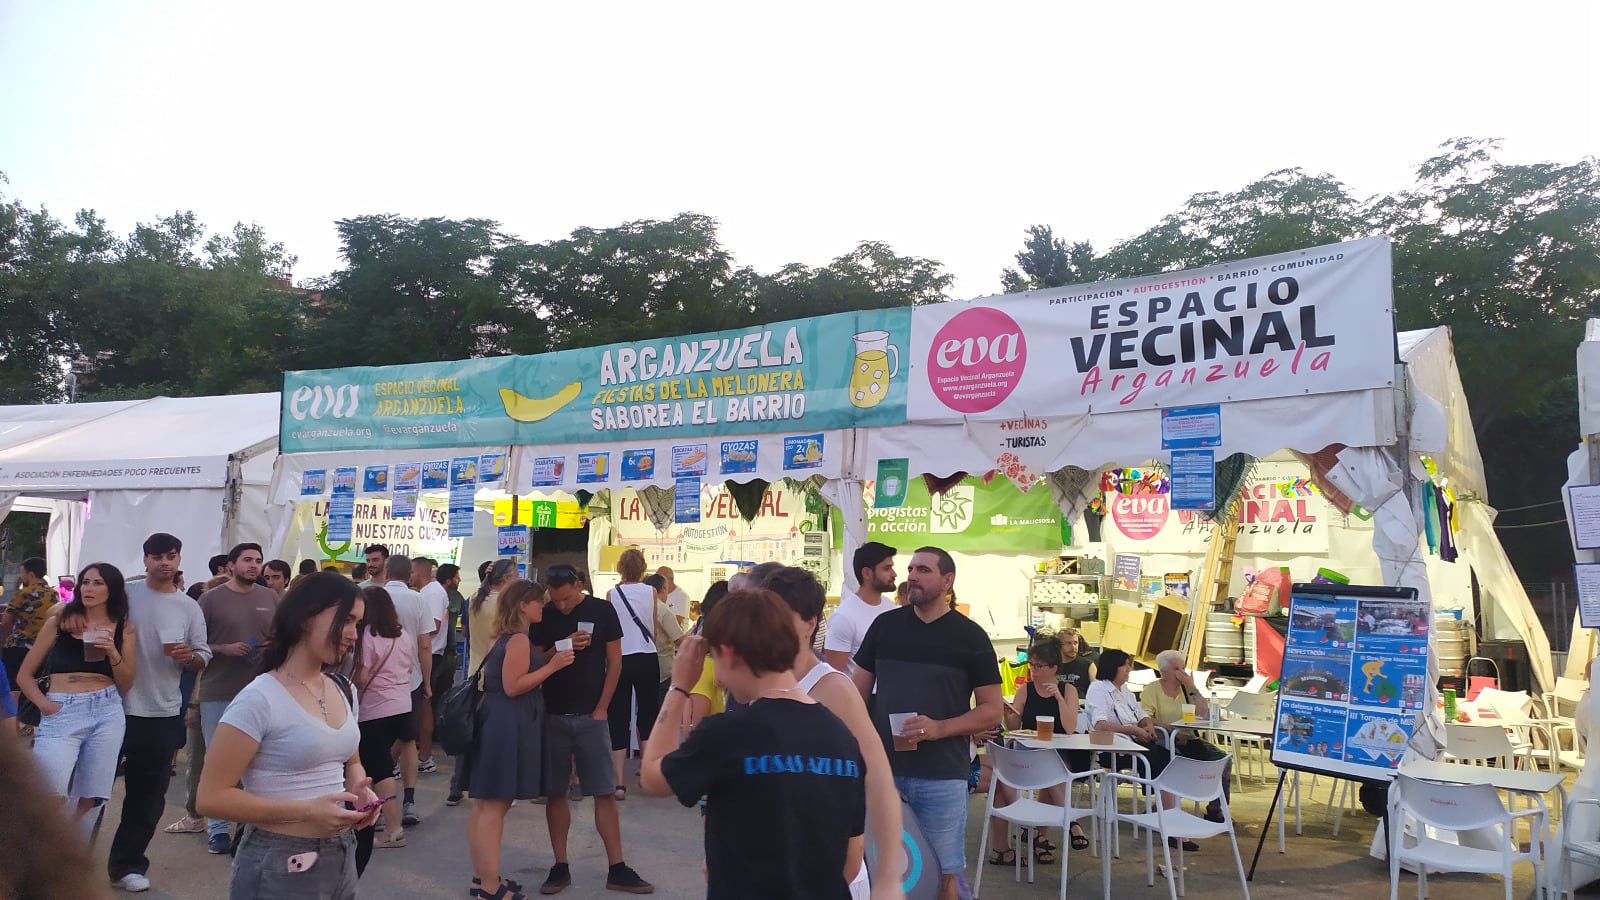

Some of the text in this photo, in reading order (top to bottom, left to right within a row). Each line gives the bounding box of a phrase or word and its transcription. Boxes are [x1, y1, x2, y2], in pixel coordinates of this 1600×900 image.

[1049, 253, 1344, 305] PARTICIPACIÓN AUTOGESTIÓN BARRIO COMUNIDAD
[1090, 276, 1299, 330] ESPACIO
[1070, 304, 1336, 374] VECINAL
[600, 326, 803, 386] ARGANZUELA
[937, 333, 1019, 368] eva
[937, 371, 1015, 385] Espacio Vecinal Arganzuela
[1081, 340, 1331, 405] Arganzuela
[375, 377, 462, 396] ESPACIO VECINAL
[591, 369, 805, 405] FIESTAS DE LA MELONERA
[943, 381, 1008, 392] www.evarganzuela.org
[290, 384, 360, 421] eva
[373, 396, 464, 417] ARGANZUELA
[591, 394, 806, 431] SABOREA EL BARRIO
[291, 427, 372, 440] evarganzuela.org
[722, 442, 756, 452] GYOZAS
[15, 470, 60, 479] ASOCIACIÓN
[62, 469, 123, 478] ENFERMEDADES
[124, 468, 148, 476] POCO
[149, 466, 201, 476] FRECUENTES
[423, 461, 448, 471] GYOZAS
[620, 497, 640, 521] LA
[705, 491, 789, 519] VECAL
[865, 505, 928, 523] ologistas
[1116, 498, 1165, 515] eva
[355, 523, 460, 542] NUESTROS CUERP
[684, 523, 728, 539] AUTOGESTIÓN
[880, 518, 927, 533] acción
[355, 542, 410, 557] TAPOCO
